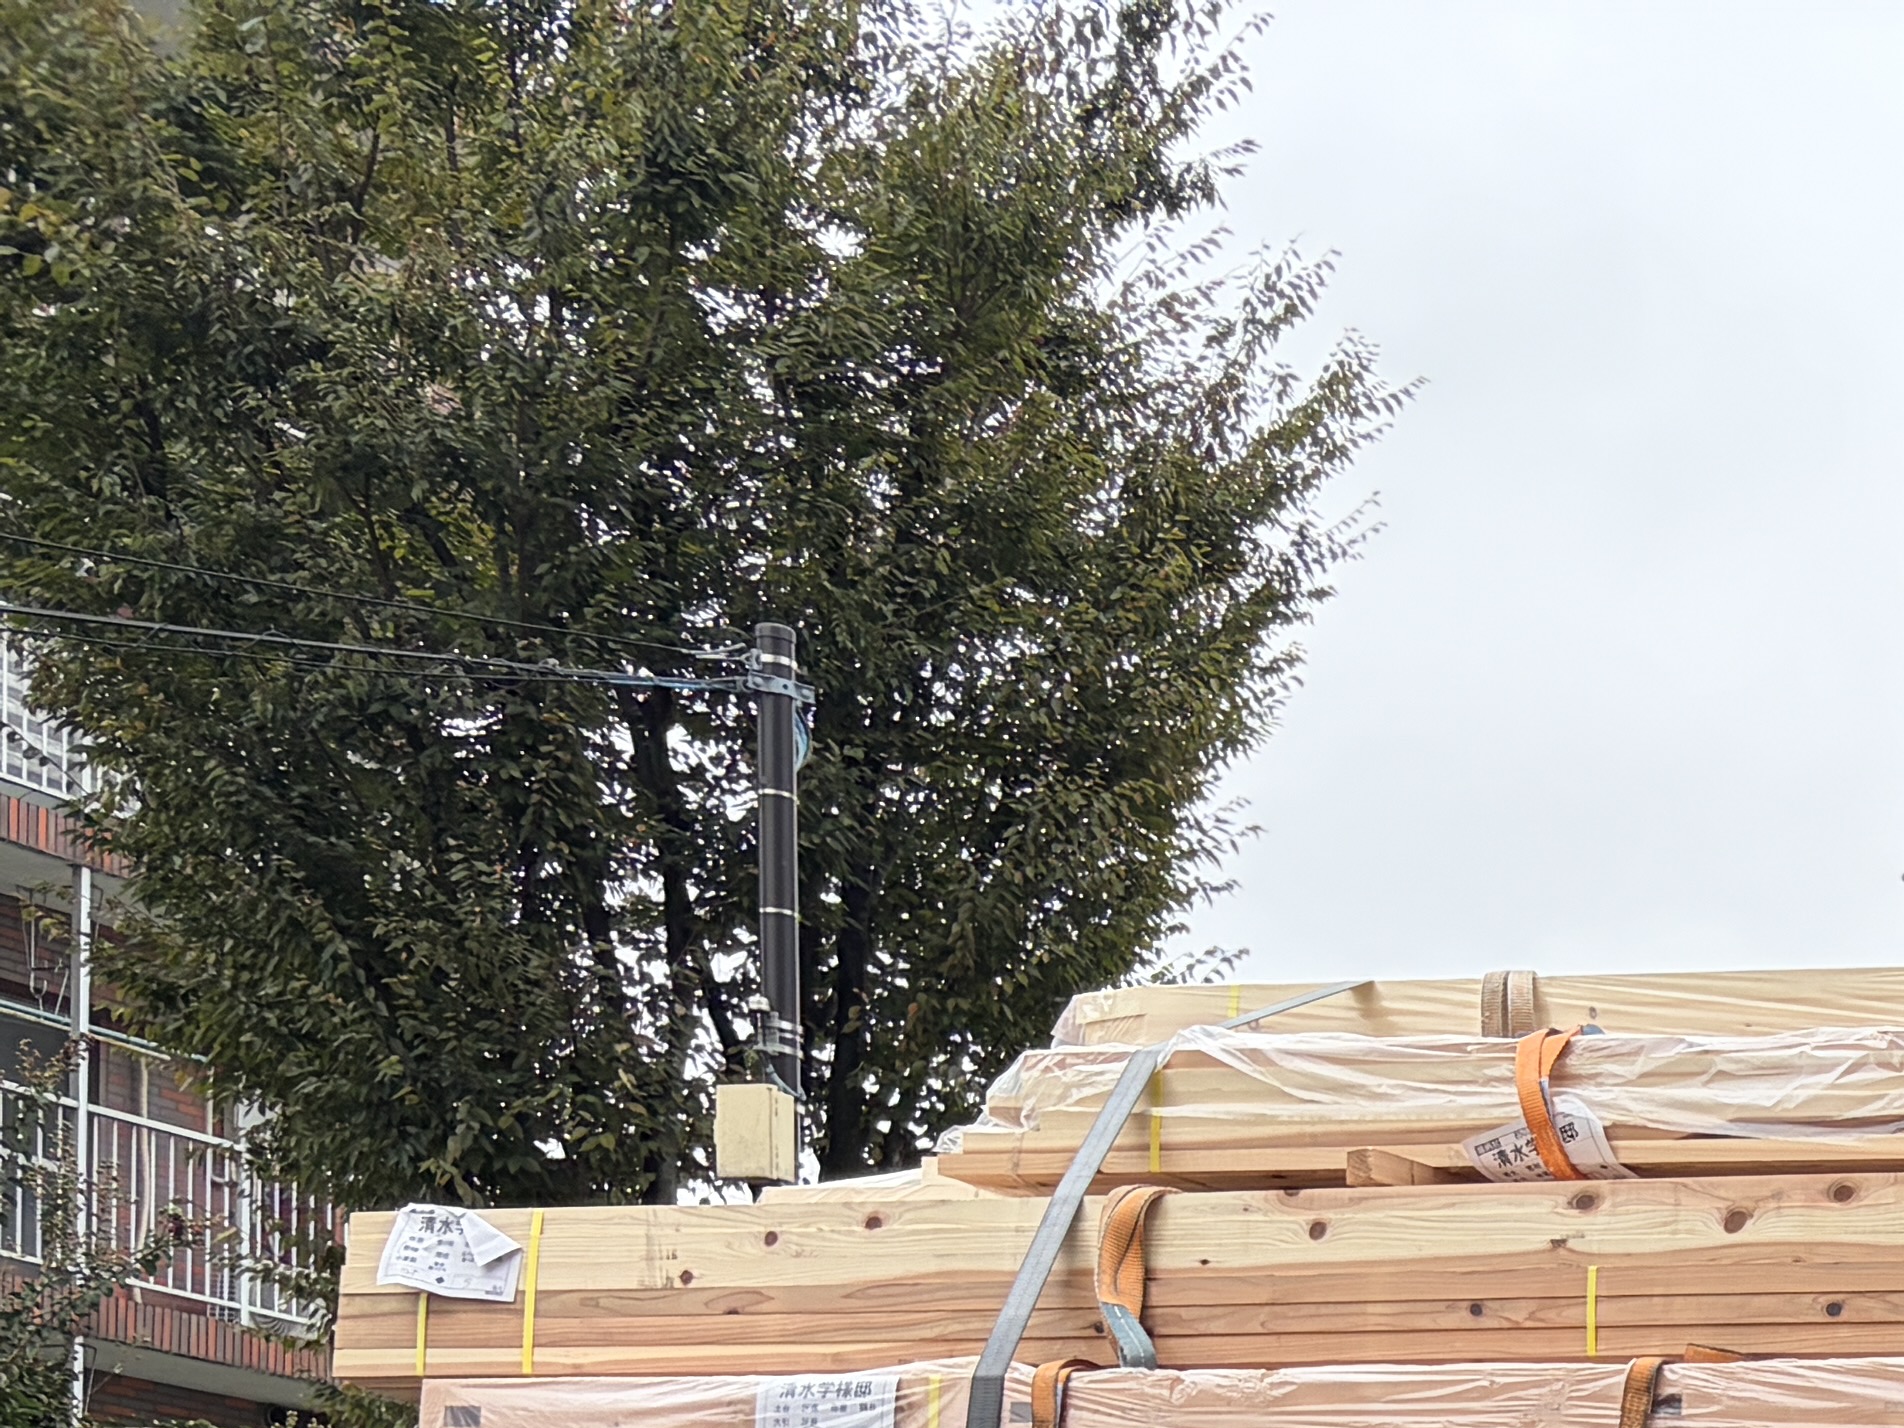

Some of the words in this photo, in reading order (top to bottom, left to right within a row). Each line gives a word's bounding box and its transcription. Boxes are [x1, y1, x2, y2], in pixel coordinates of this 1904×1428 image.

[779, 1380, 873, 1399] 清水学様邸
